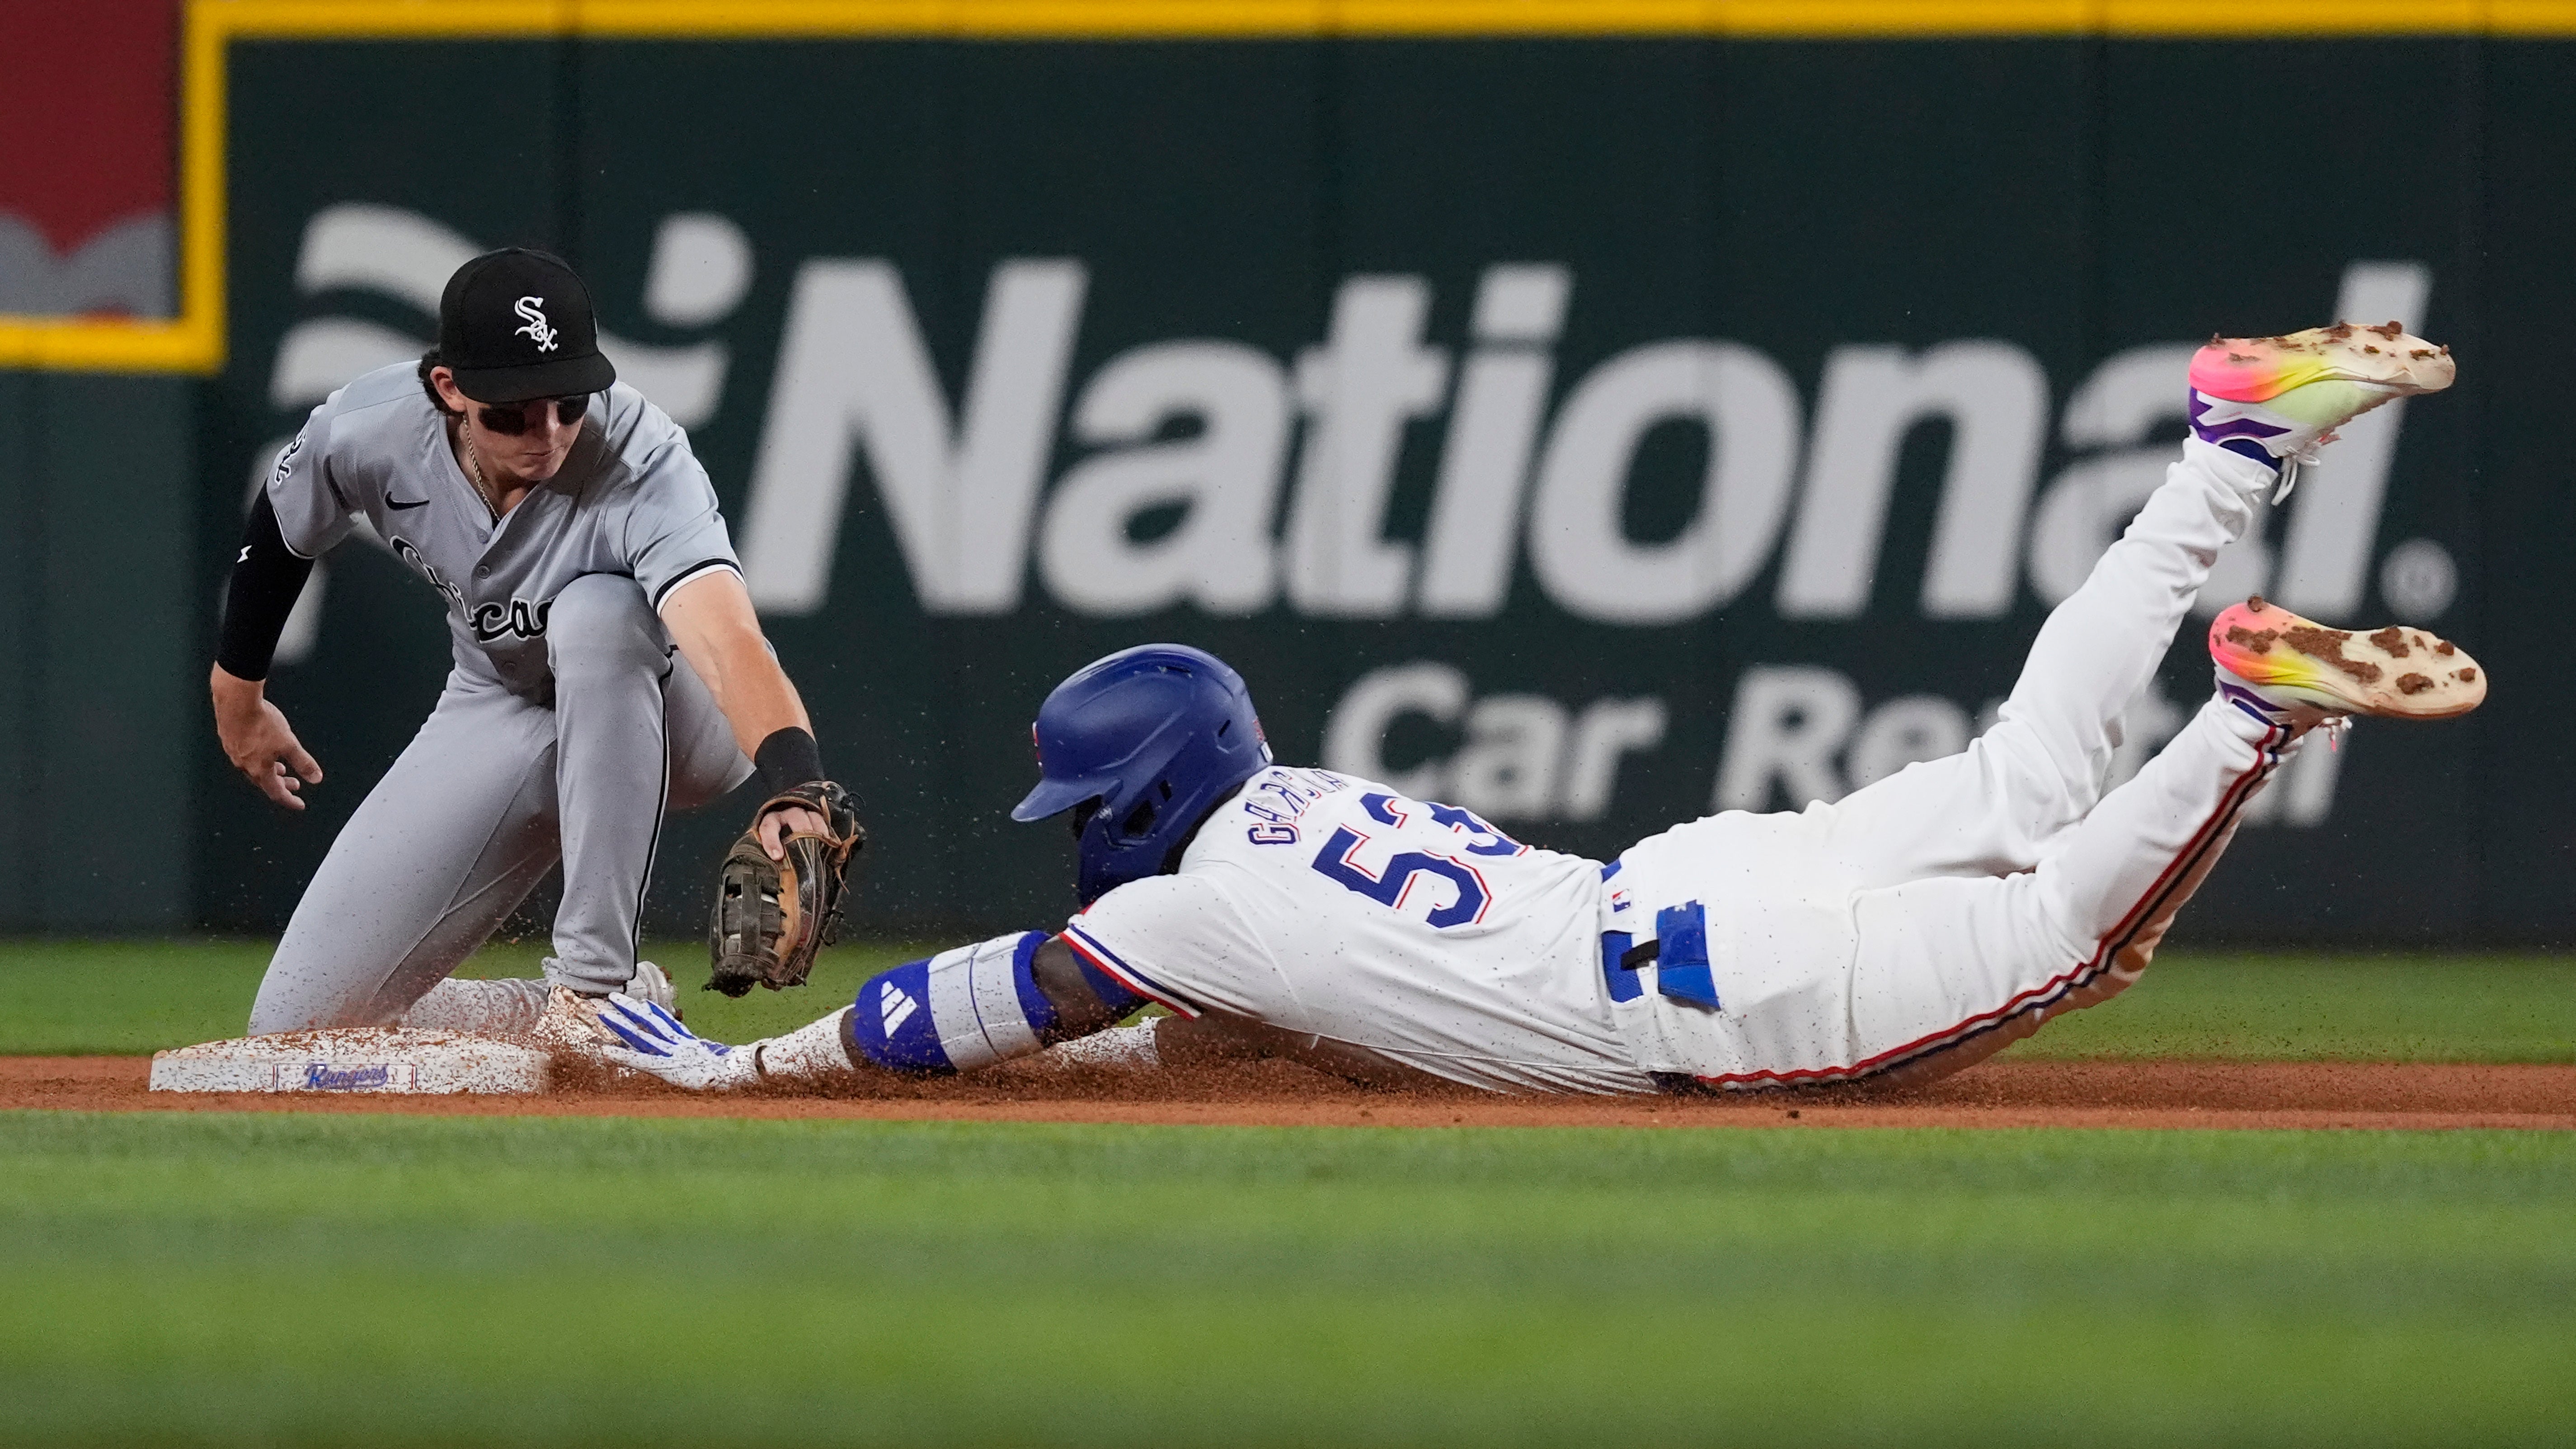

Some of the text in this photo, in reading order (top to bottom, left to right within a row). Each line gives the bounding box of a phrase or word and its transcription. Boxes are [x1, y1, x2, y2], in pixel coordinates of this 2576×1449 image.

[514, 296, 558, 353] Sox
[1325, 663, 1668, 825] Car
[1312, 793, 1532, 928] 53
